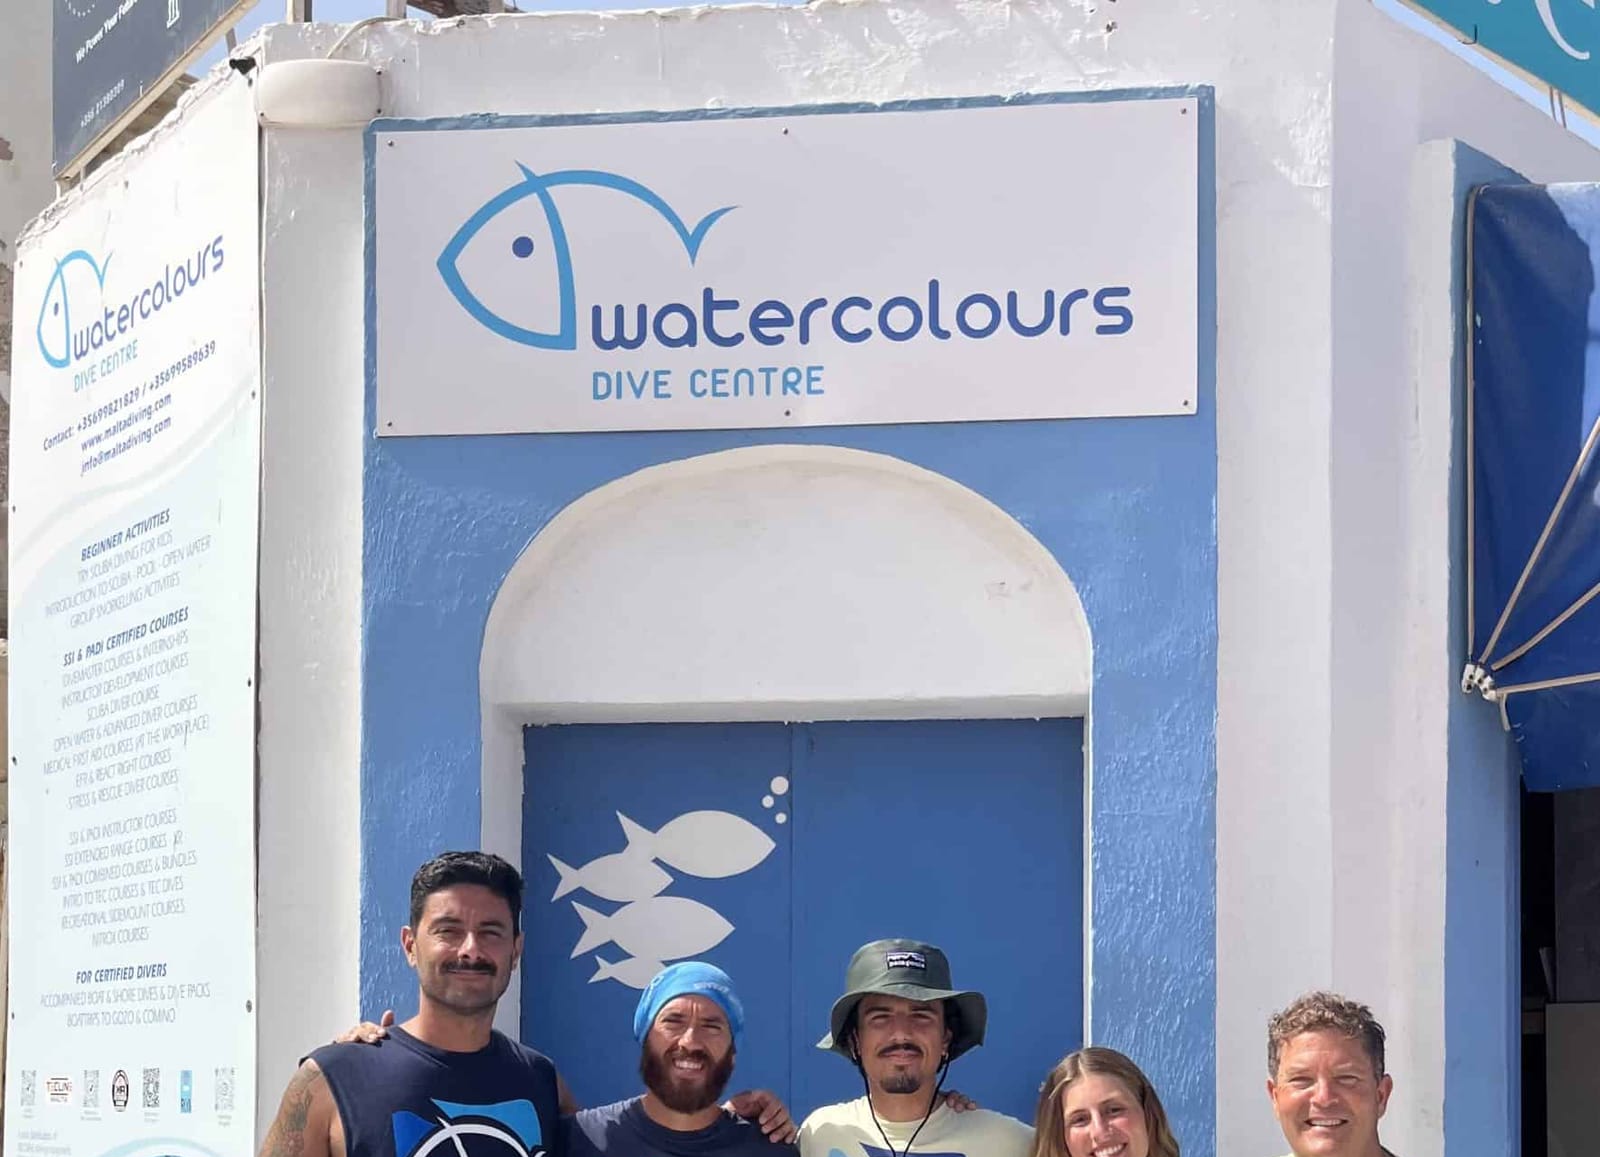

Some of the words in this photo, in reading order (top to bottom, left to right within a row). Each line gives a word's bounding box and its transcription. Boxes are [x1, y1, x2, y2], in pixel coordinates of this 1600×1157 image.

[74, 235, 224, 360] watercolours
[591, 279, 1133, 350] watercolours
[74, 364, 97, 392] DIVE
[101, 339, 138, 378] CENTRE
[592, 370, 671, 401] DIVE
[690, 366, 825, 397] CENTRE
[81, 393, 172, 452] www.maltadiving.com
[43, 426, 74, 451] Contact:
[81, 416, 172, 473] info@maltadiving.com
[81, 531, 122, 561] BEGINNER
[125, 508, 170, 543] ACTIVITIES
[90, 558, 113, 579] SCUBA
[114, 546, 139, 568] DIVING
[140, 538, 156, 556] FOR
[136, 561, 155, 579] POOL
[162, 548, 185, 568] OPEN
[143, 571, 182, 599] ACTIVITIES
[63, 653, 74, 667] SSI
[77, 649, 82, 661] &
[85, 640, 104, 659] PADI
[106, 623, 147, 651] CERTIFIED
[149, 606, 189, 634] COURSES
[104, 650, 135, 673] COURSES
[154, 652, 189, 677] COURSES
[87, 703, 109, 721] SCUBA
[110, 694, 130, 714] DIVER
[131, 684, 160, 706] COURSE
[54, 737, 73, 752] OPEN
[73, 728, 95, 746] WATER
[103, 713, 140, 737] ADVANCED
[141, 706, 162, 725] DIVER
[164, 694, 198, 718] COURSES
[103, 738, 134, 759] COURSES
[139, 747, 172, 770] COURSES
[125, 777, 145, 796] DIVER
[146, 769, 179, 791] COURSES
[144, 808, 177, 829] COURSES
[135, 833, 167, 853] COURSES
[121, 859, 153, 878] COURSES
[161, 849, 198, 870] BUNDLES
[108, 883, 139, 902] COURSES
[151, 898, 185, 917] COURSES
[117, 926, 150, 944] COURSES
[76, 971, 92, 984] FOR
[95, 966, 134, 982] CERTIFIED
[137, 963, 167, 979] DIVERS
